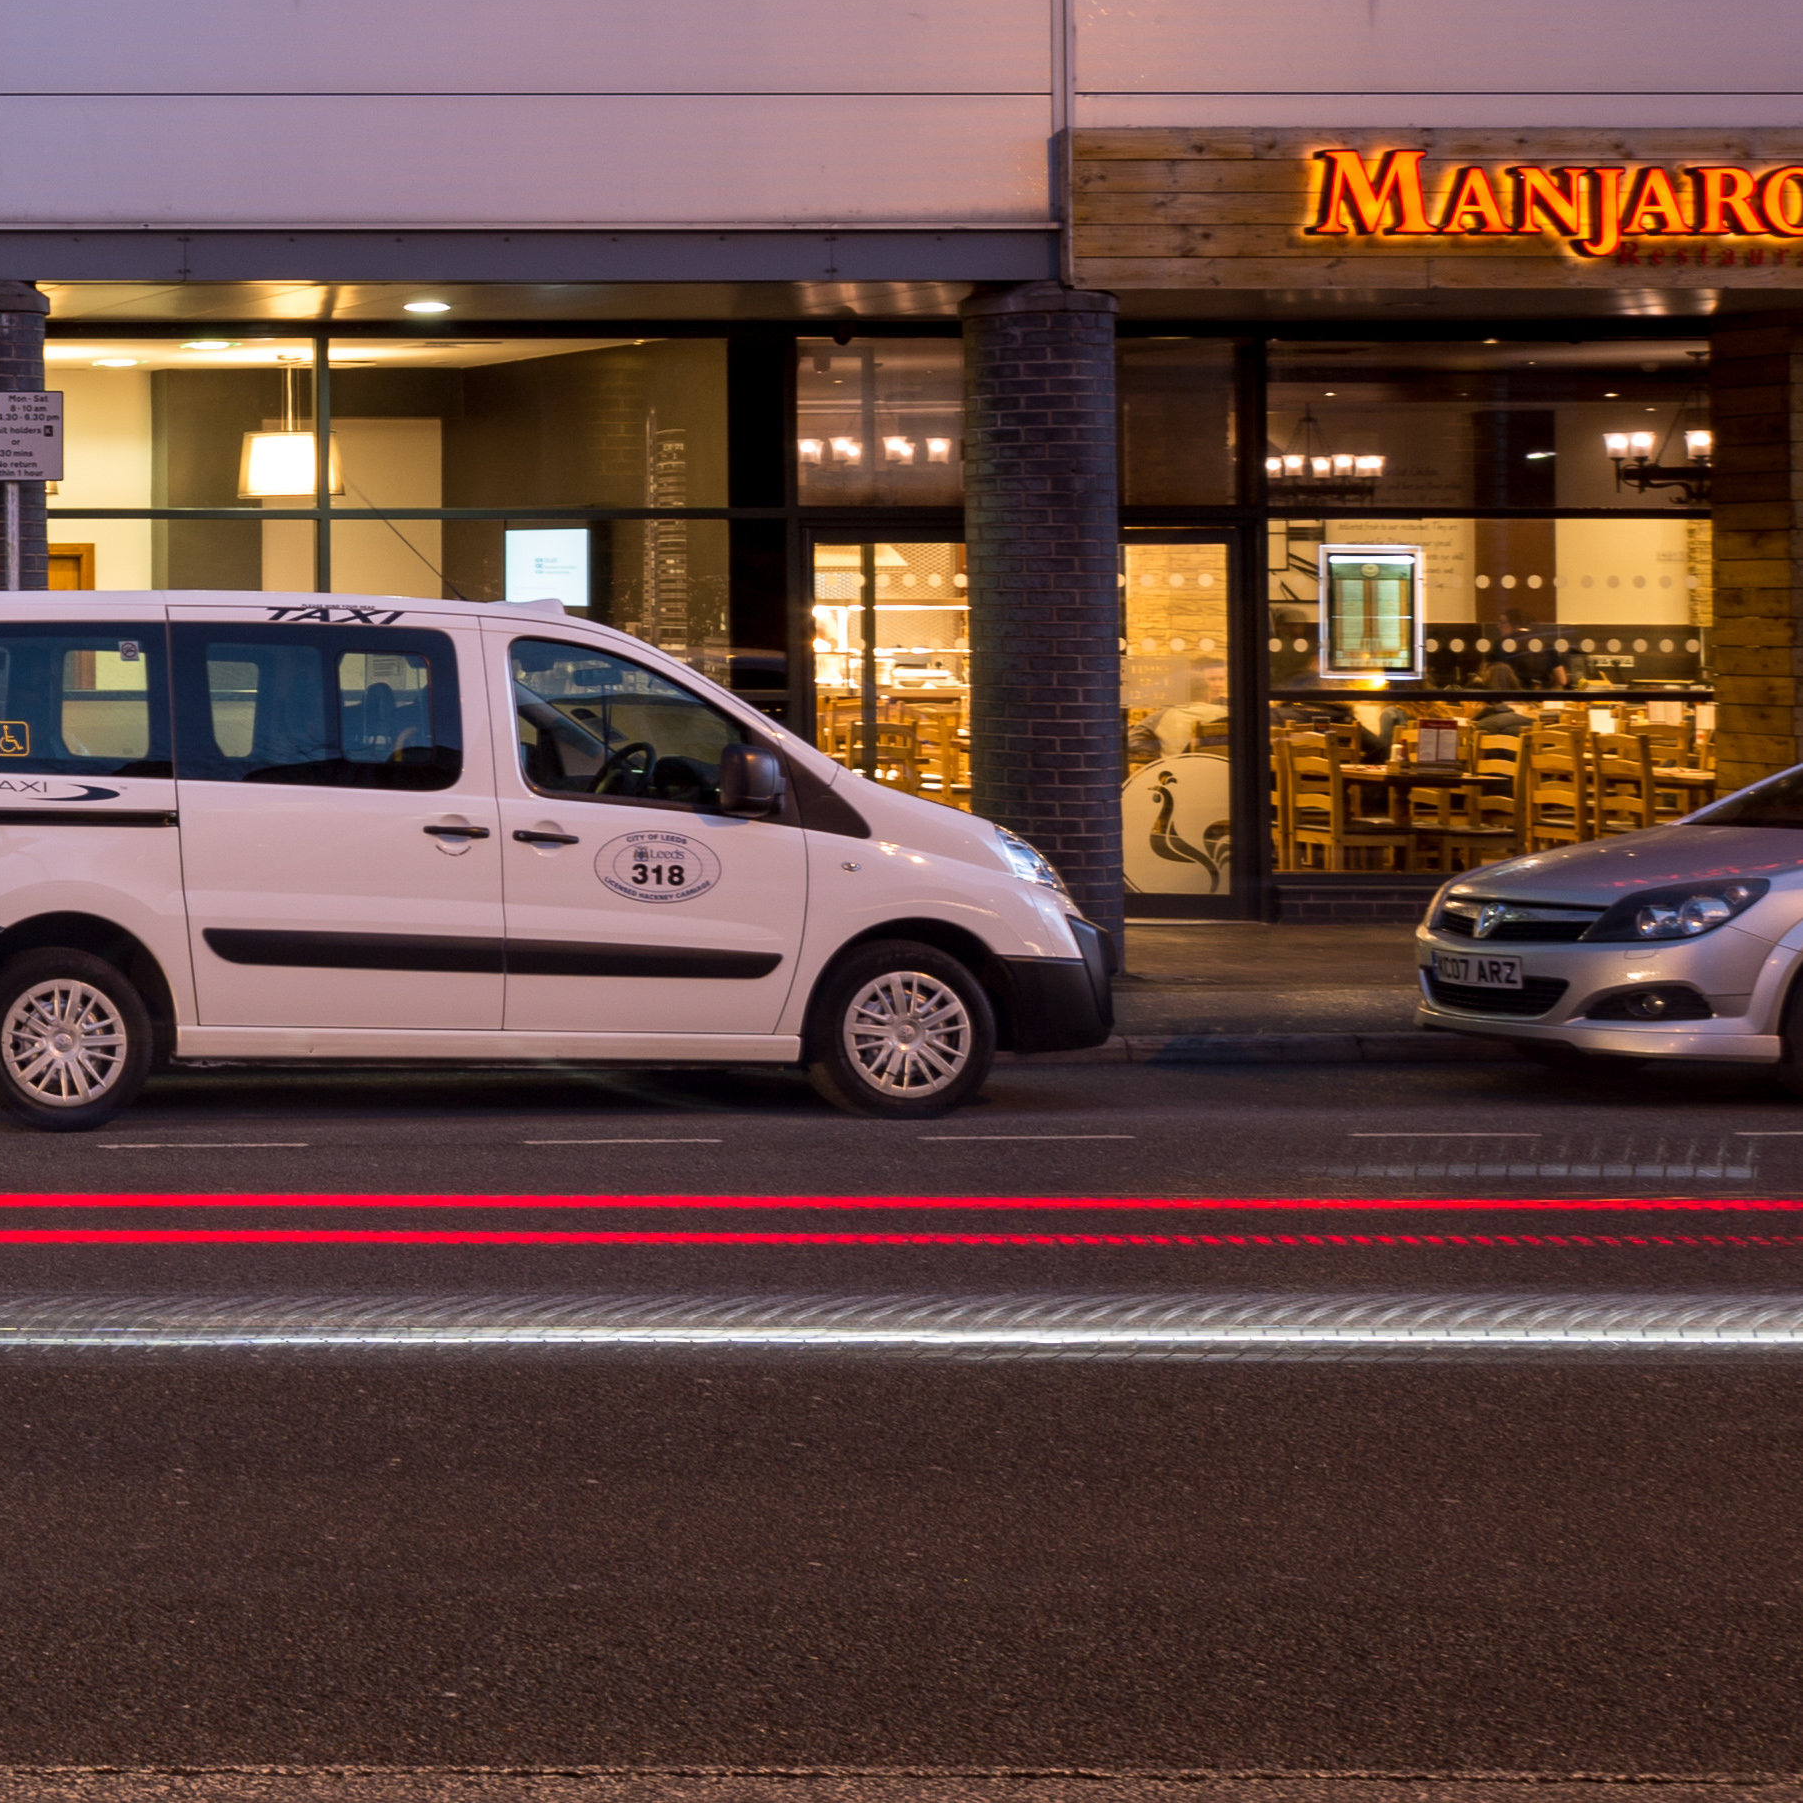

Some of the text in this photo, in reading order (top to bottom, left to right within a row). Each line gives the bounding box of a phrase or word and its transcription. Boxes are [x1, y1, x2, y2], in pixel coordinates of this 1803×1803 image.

[1616, 241, 1803, 266] Restaur
[33, 394, 49, 402] Sat
[10, 426, 42, 434] holders
[0, 449, 33, 457] 30 mins
[10, 460, 38, 468] return
[24, 469, 43, 477] hour
[266, 607, 406, 625] TAXI
[626, 834, 645, 843] CITY
[661, 834, 687, 845] LEEDS
[650, 849, 685, 860] Leeds
[631, 863, 685, 886] 318
[604, 876, 711, 900] LICENSED HACKNEY CARRIAGE
[1477, 960, 1518, 984] ARZ
